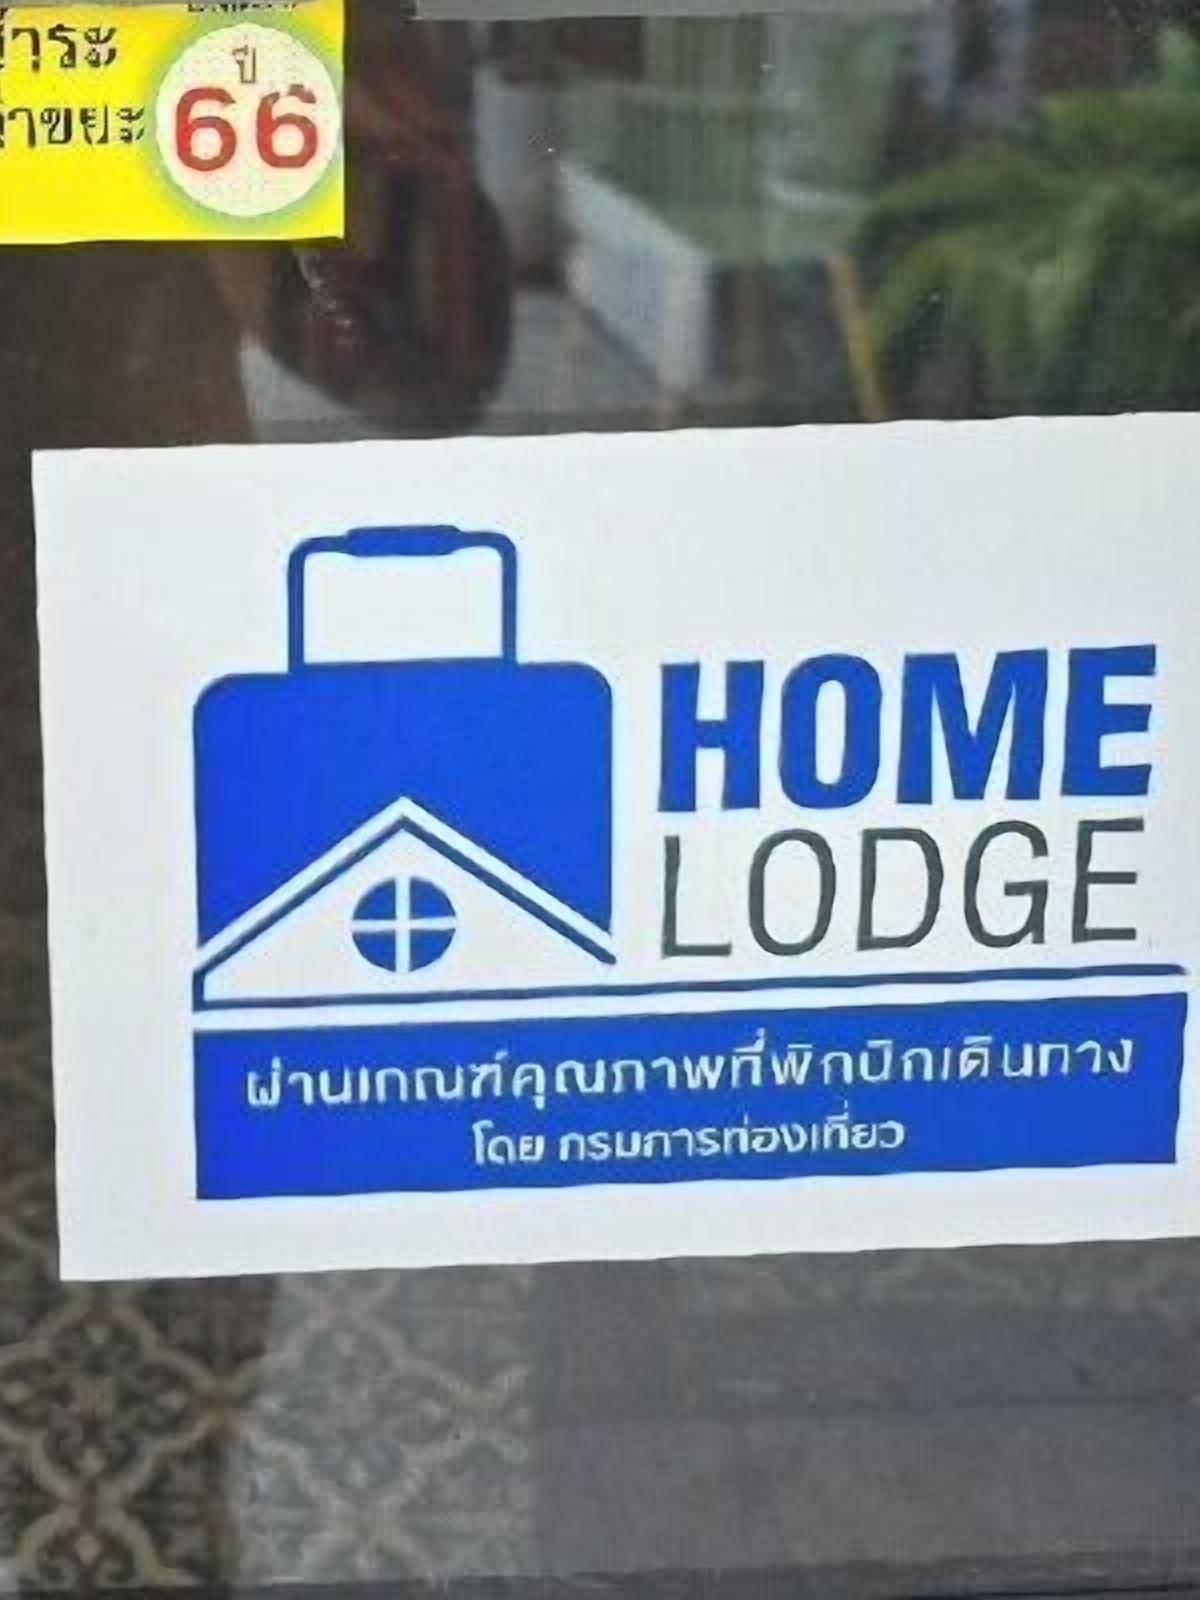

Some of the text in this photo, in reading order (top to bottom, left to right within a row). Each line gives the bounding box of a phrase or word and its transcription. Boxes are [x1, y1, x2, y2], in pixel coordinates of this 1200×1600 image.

[174, 84, 320, 173] 66
[656, 643, 1157, 813] HOME
[661, 817, 1145, 959] LODGE
[471, 1099, 907, 1165] โดย กรมการท่องเที่ยว
